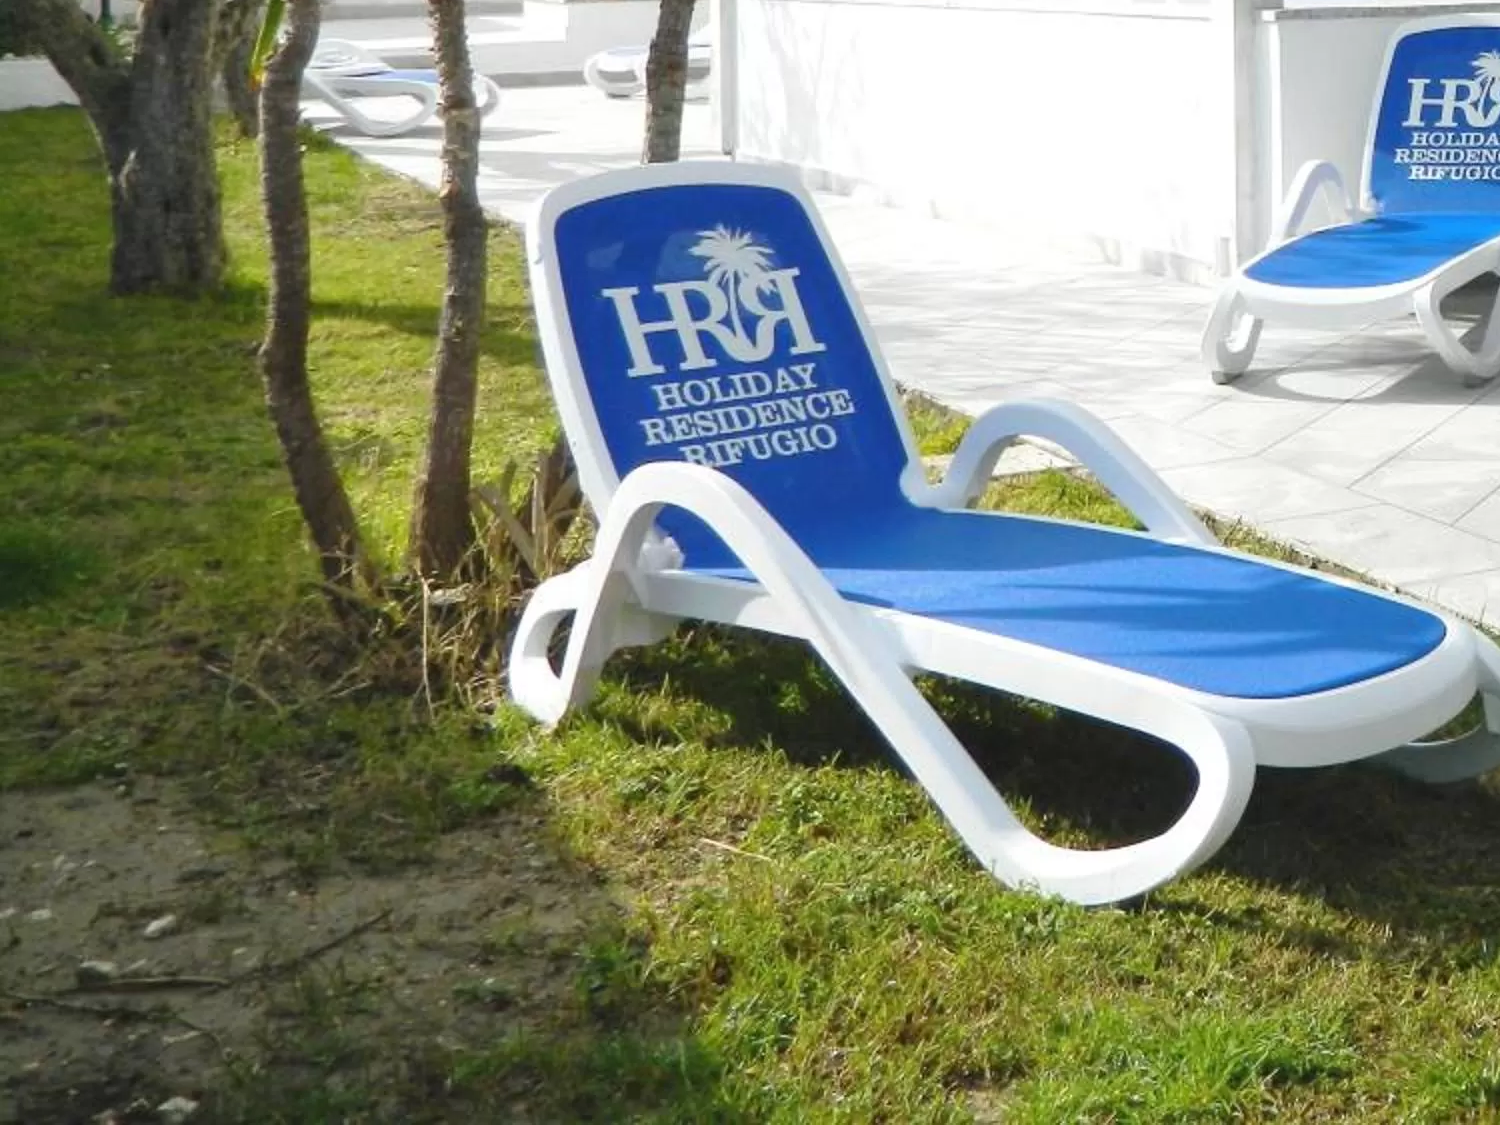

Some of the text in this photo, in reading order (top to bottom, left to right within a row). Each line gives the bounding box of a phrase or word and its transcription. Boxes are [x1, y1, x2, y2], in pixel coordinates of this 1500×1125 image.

[651, 362, 818, 411] HOLIDAY
[640, 388, 855, 446] RESIDENCE
[679, 424, 838, 468] RIFUGIO
